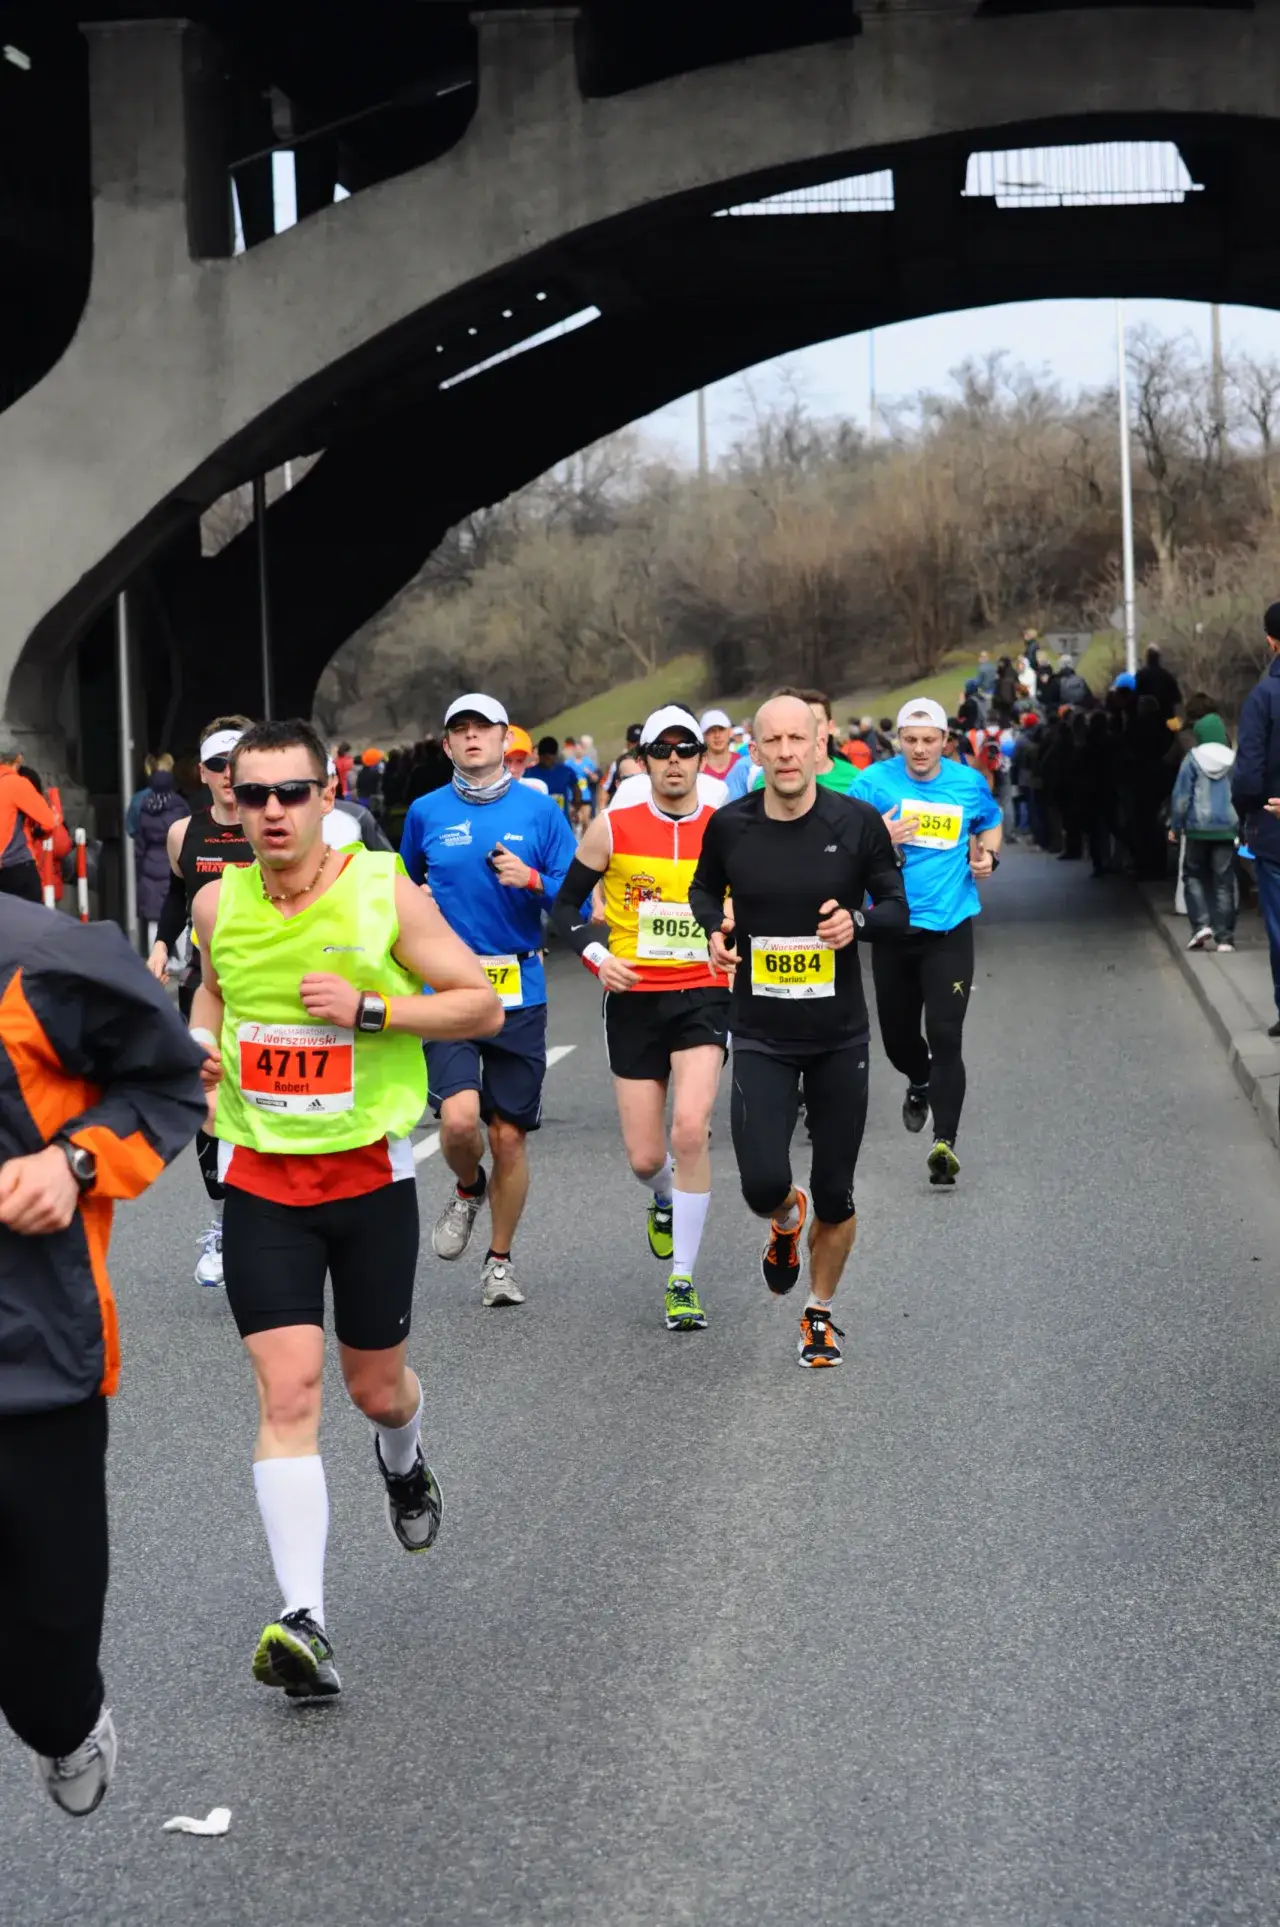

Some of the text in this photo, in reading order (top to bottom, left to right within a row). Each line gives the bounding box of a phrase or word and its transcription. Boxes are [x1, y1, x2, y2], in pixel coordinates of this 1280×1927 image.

[914, 814, 952, 832] 354
[652, 918, 702, 938] 8052
[765, 953, 821, 973] 6884
[487, 968, 509, 984] 57
[263, 1033, 337, 1046] Warszawski
[256, 1048, 329, 1078] 4717
[274, 1081, 310, 1093] Robert
